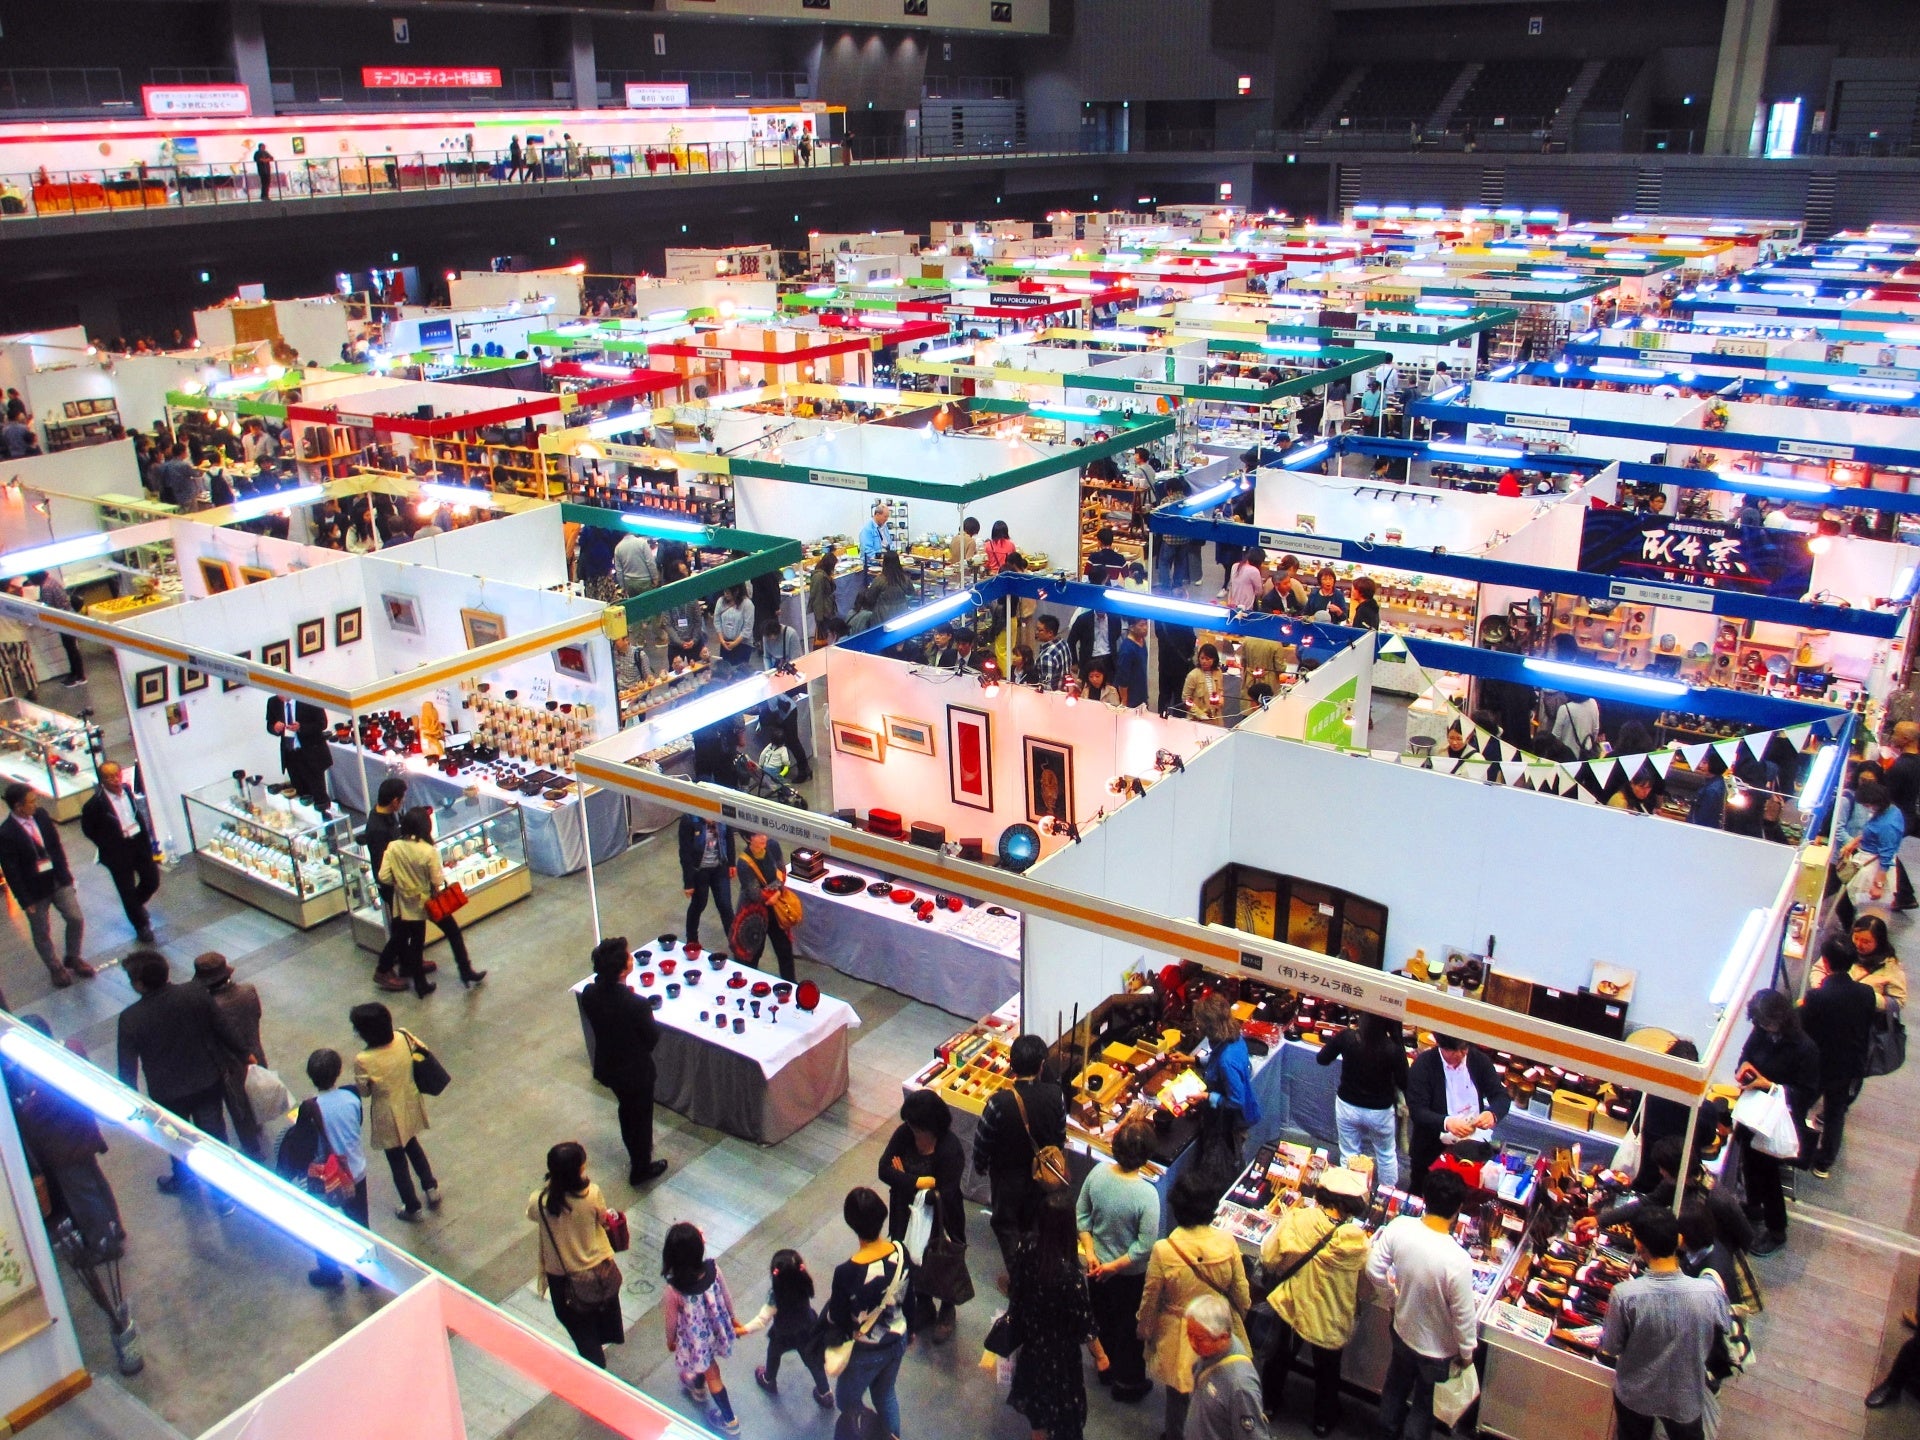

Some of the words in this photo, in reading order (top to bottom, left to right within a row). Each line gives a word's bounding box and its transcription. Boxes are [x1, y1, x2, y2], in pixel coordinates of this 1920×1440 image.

[396, 24, 407, 41] J
[374, 71, 493, 86] テーブルコーディネート作品展示
[993, 295, 1007, 303] ARITA
[1008, 296, 1037, 304] PORCELAIN
[1303, 542, 1326, 551] factory
[738, 810, 759, 825] 輪島塗
[761, 817, 811, 839] 暮らしの塗師屋
[1277, 964, 1364, 998] (有)キタムラ商会
